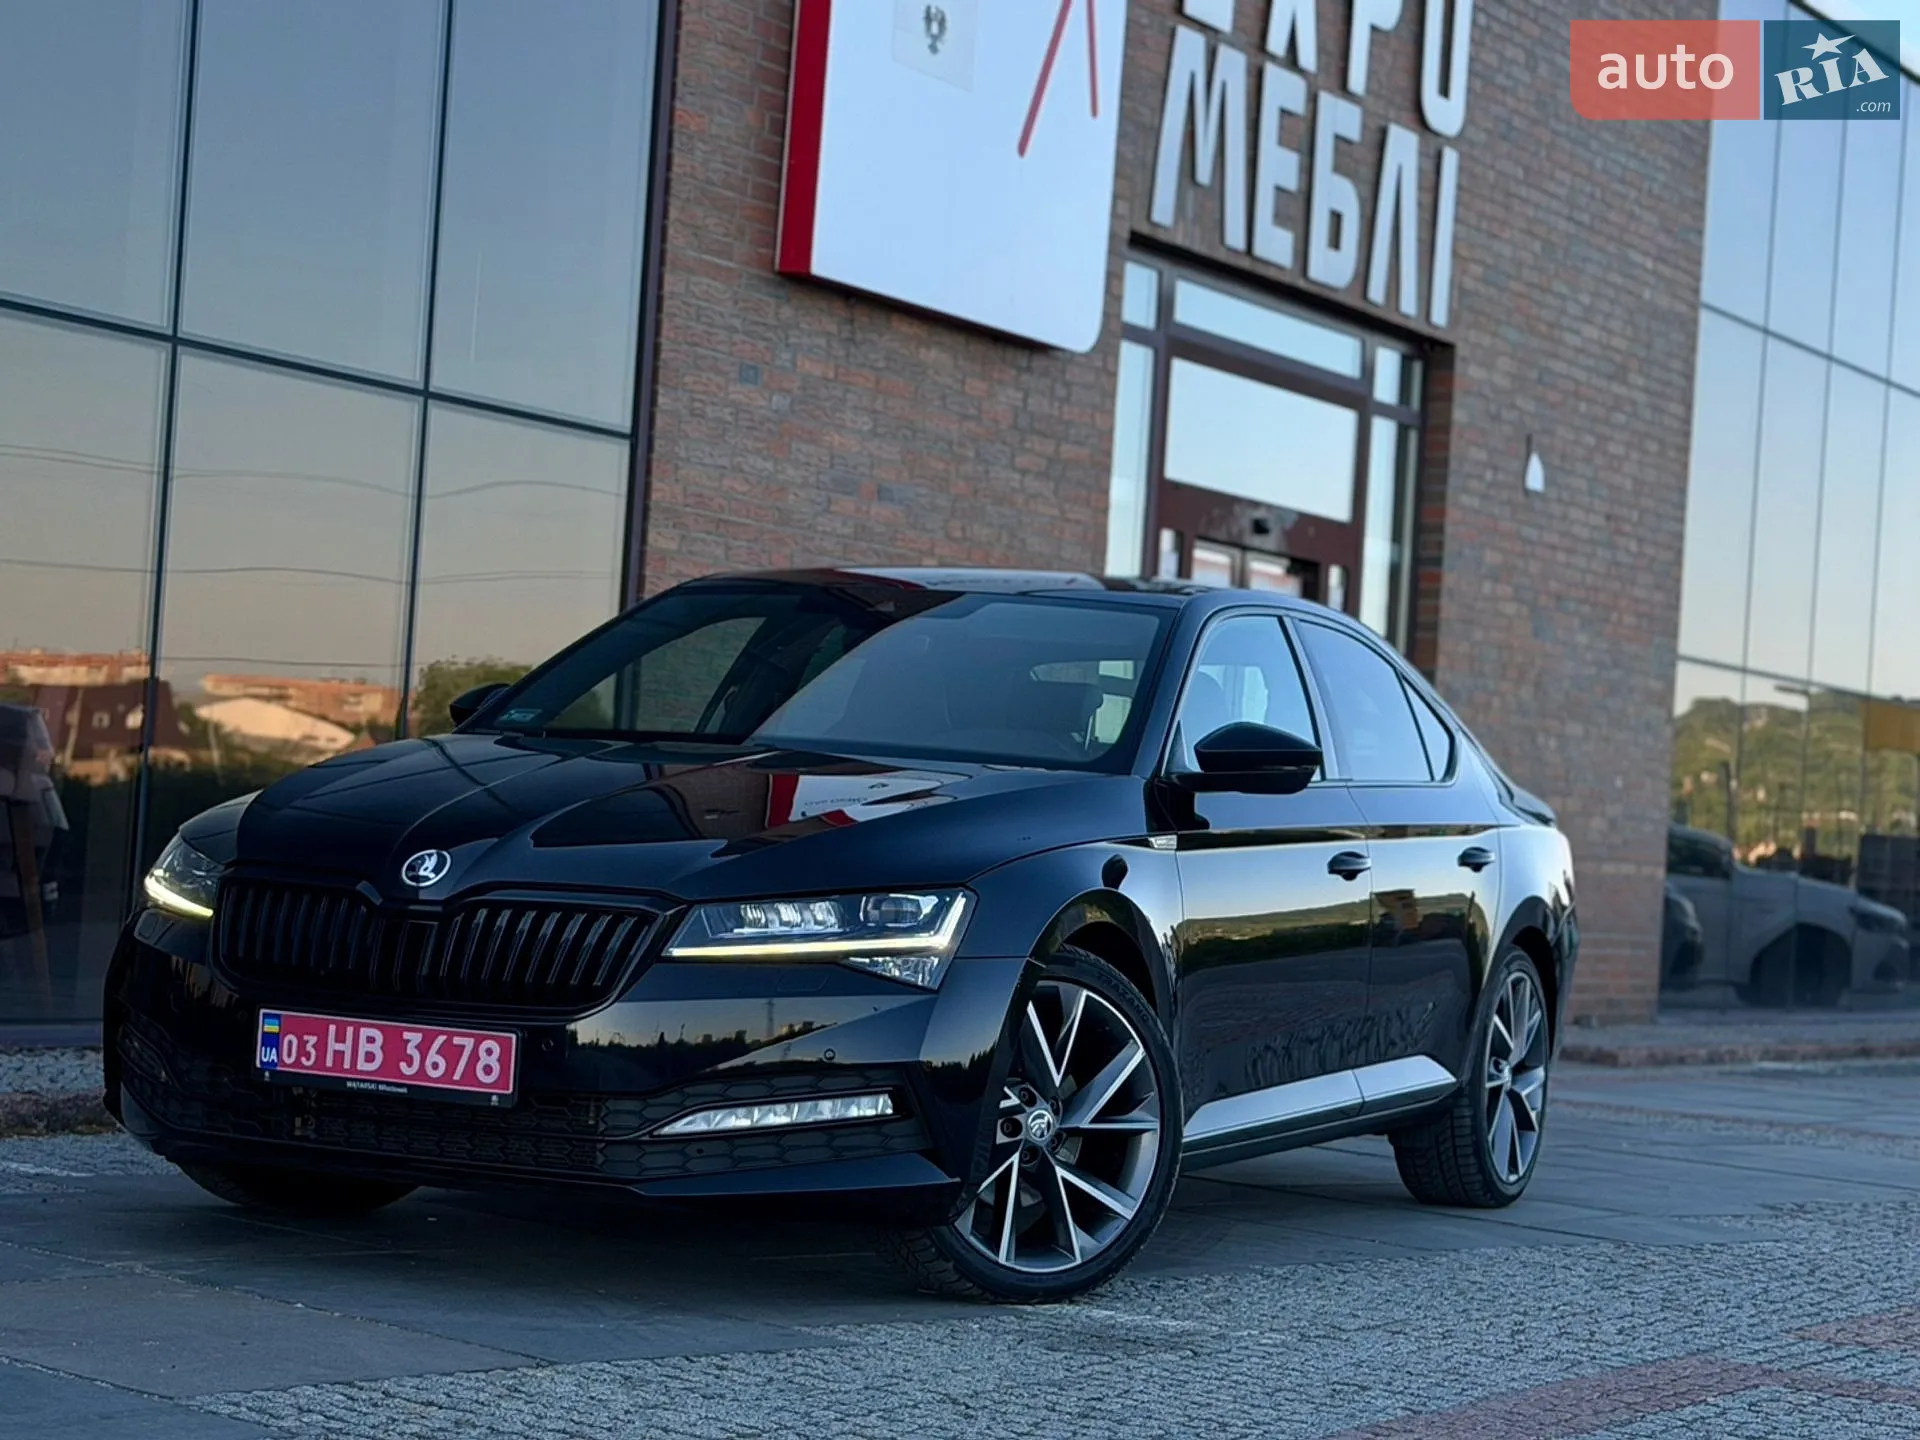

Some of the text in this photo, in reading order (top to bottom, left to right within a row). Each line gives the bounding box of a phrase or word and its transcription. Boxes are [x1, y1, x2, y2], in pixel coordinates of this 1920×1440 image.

[1151, 23, 1459, 329] МЕБЛІ
[261, 1047, 278, 1063] UA
[282, 1024, 501, 1084] 03 HB 3678
